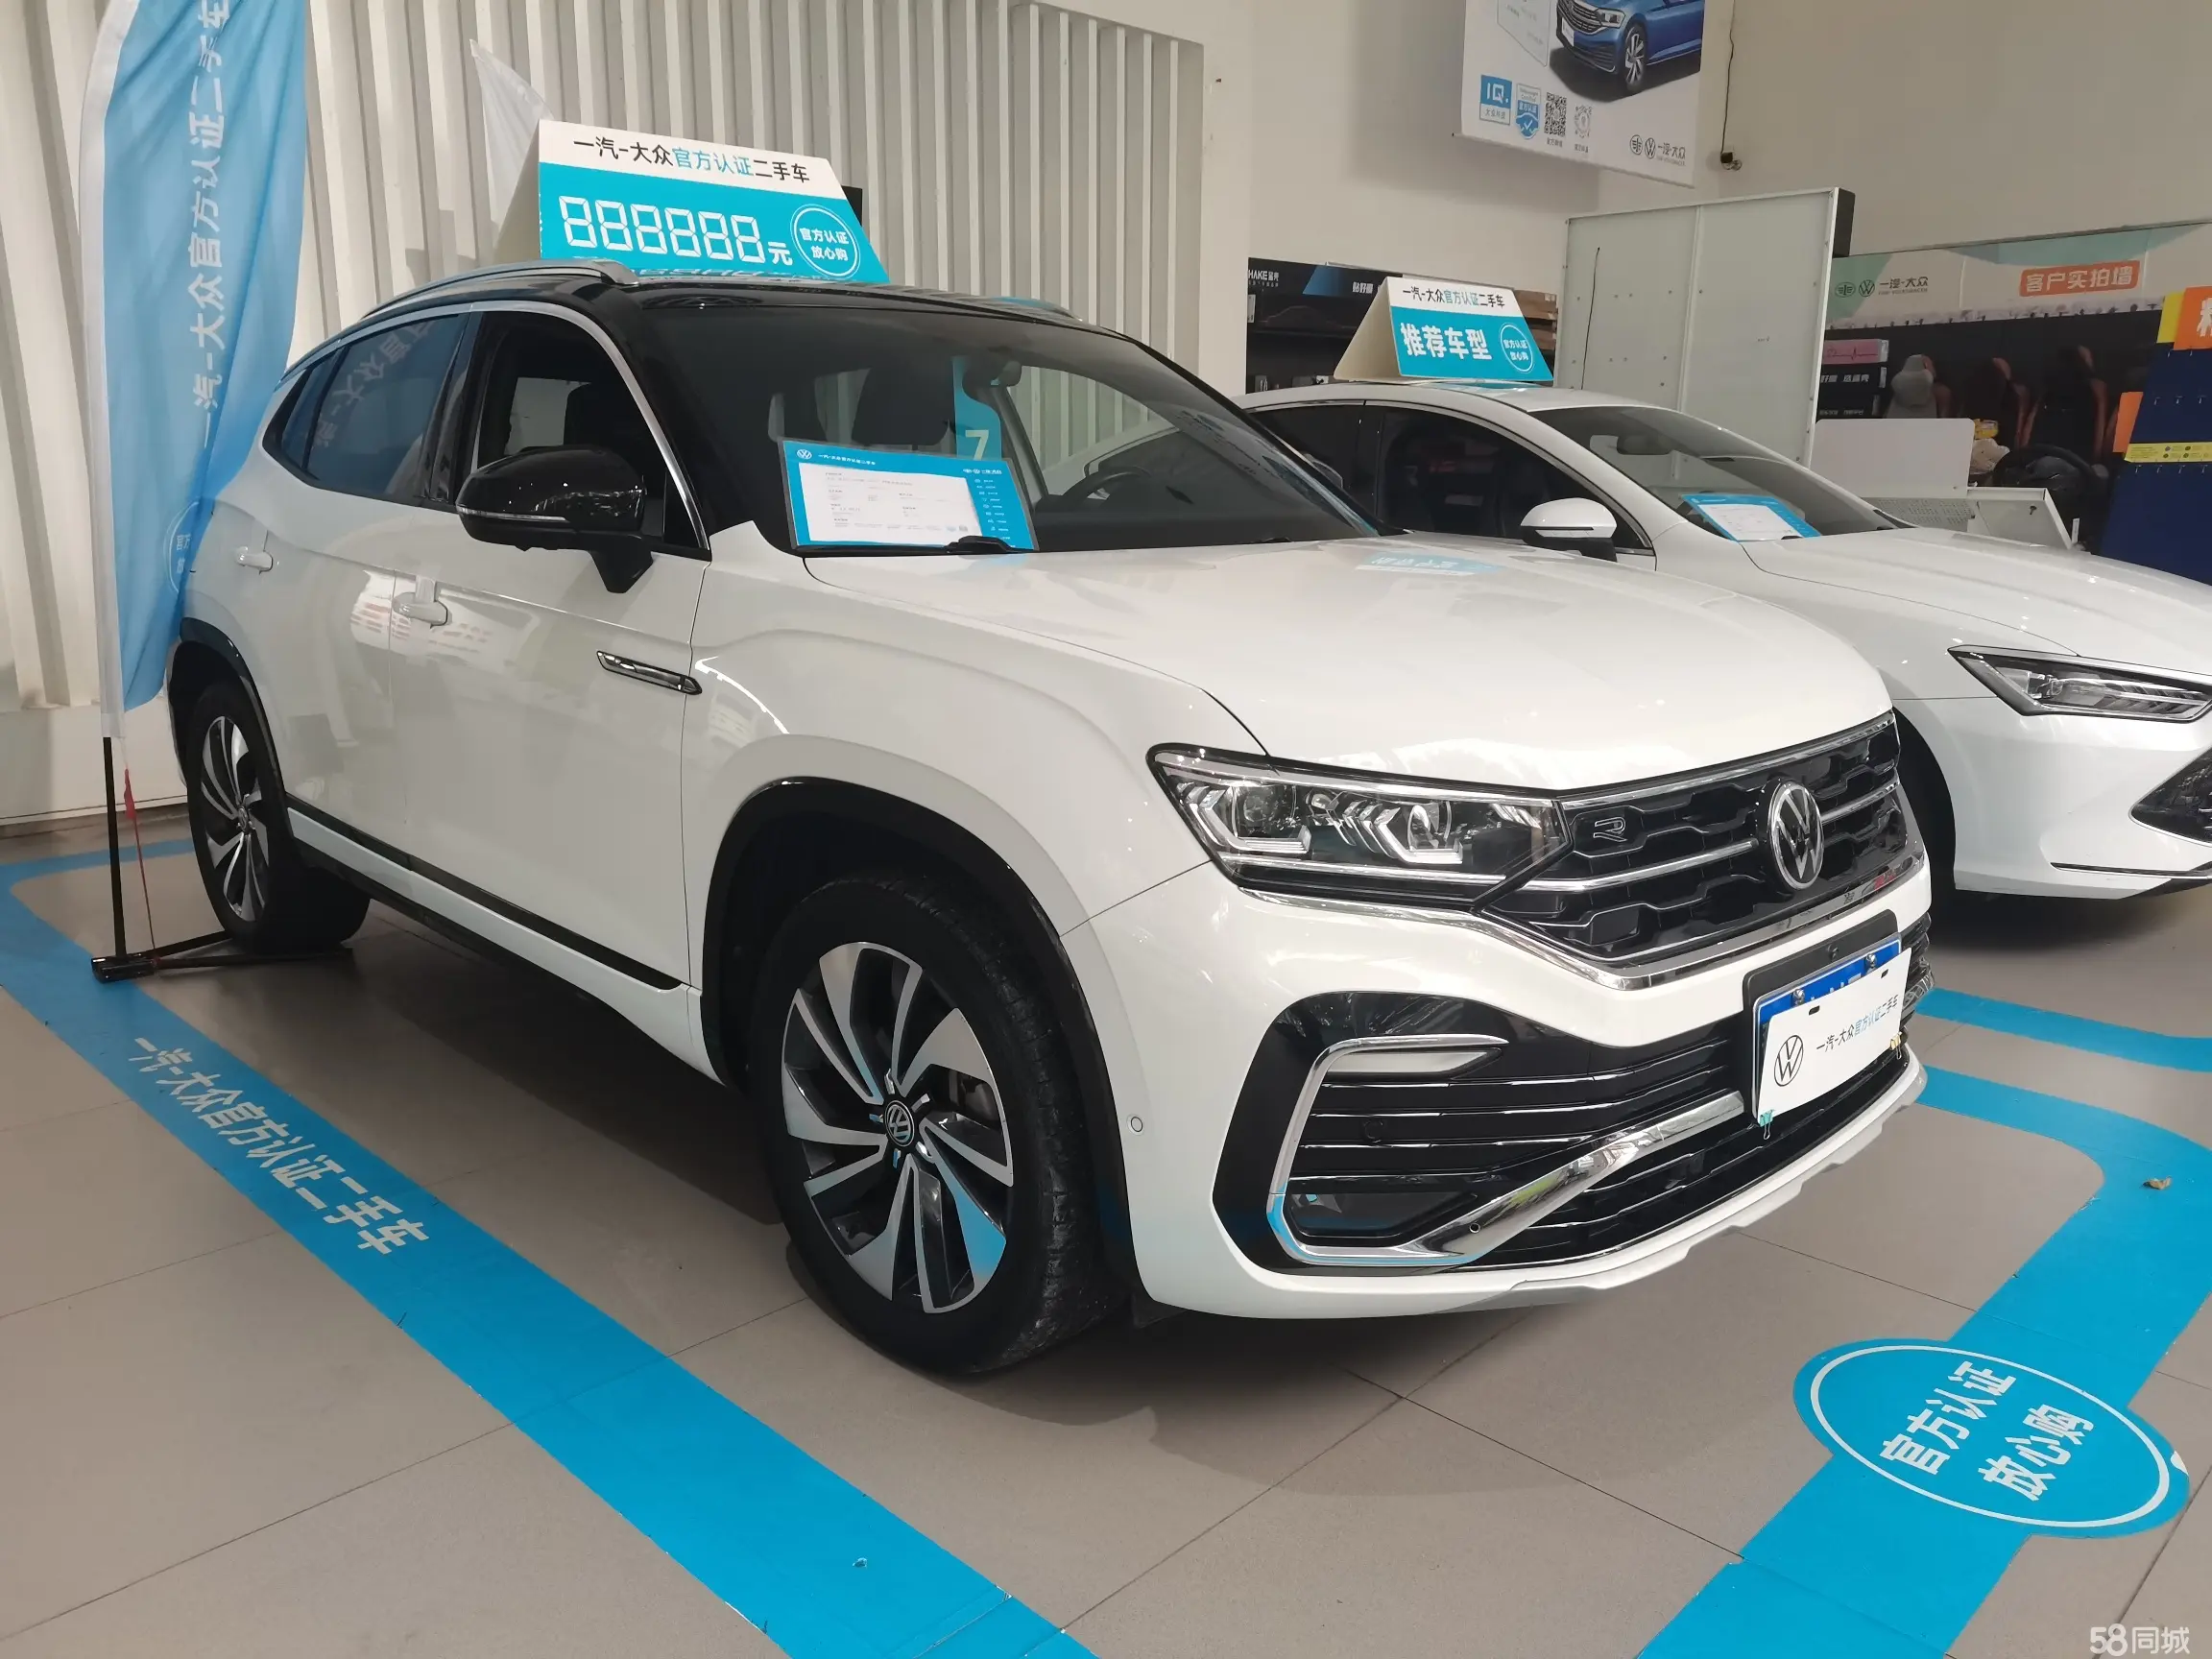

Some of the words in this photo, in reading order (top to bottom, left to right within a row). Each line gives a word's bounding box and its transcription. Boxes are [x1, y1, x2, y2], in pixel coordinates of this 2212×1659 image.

[574, 135, 810, 183] 一汽-大众官方认证二手车
[799, 227, 850, 245] 官方认证
[810, 245, 849, 261] 放心购
[1403, 286, 1505, 308] 一汽-大众官方认证二手车
[2026, 265, 2133, 293] 客户实拍墙
[1400, 322, 1493, 361] 推荐车型
[965, 429, 990, 461] 7
[1815, 995, 1899, 1053] 一汽-大众官方认证二手车
[128, 1037, 430, 1256] 一汽-大众官方认证二手车
[1879, 1360, 2017, 1476] 官方认证
[1978, 1404, 2095, 1502] 放心购
